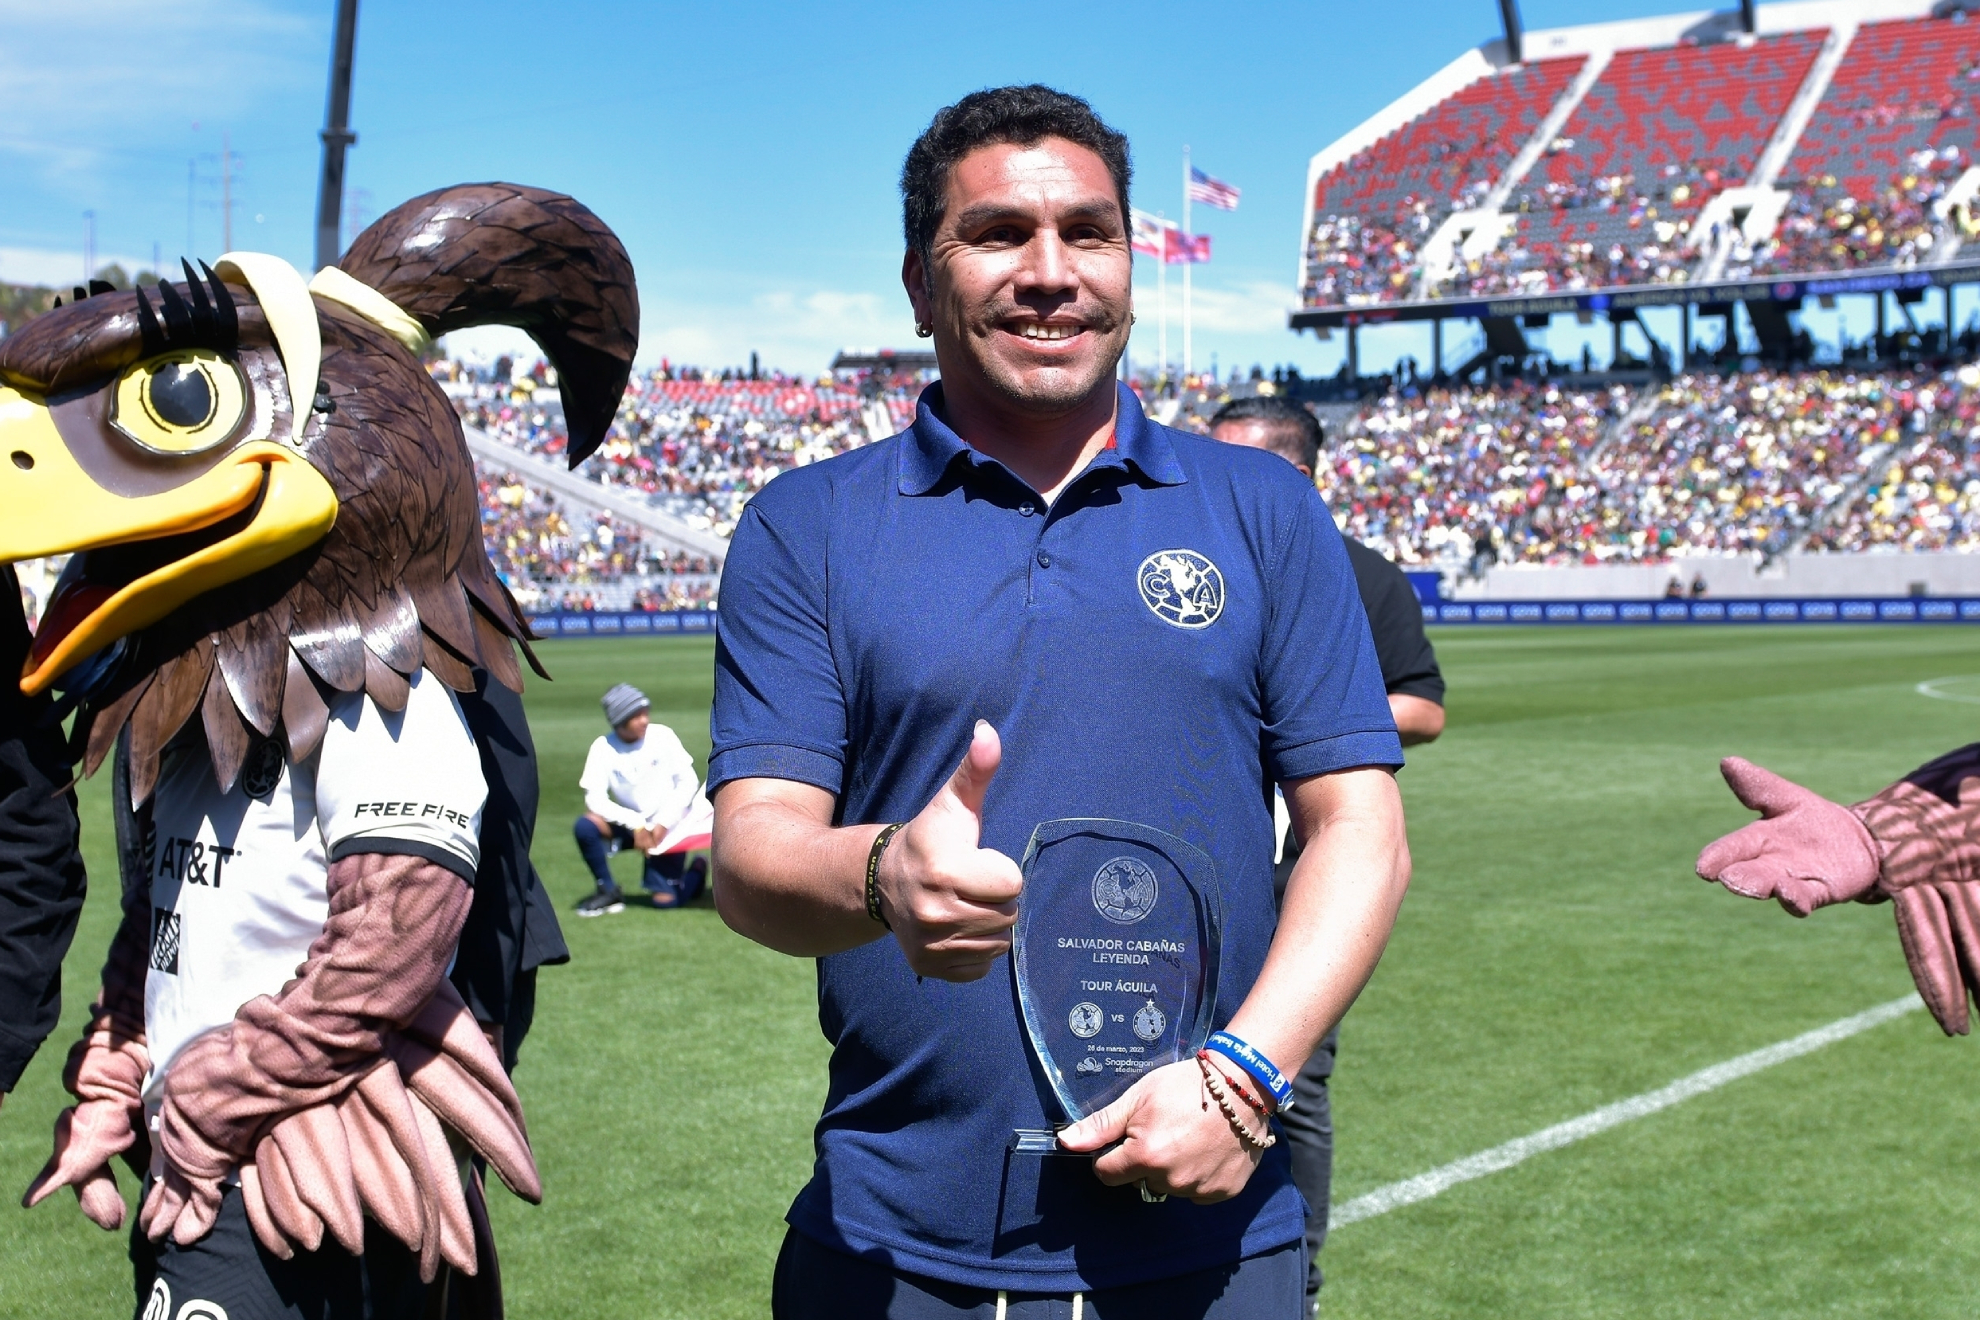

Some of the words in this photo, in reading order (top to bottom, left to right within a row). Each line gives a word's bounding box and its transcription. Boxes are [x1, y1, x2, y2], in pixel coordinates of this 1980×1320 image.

[354, 802, 418, 818] FREE
[158, 837, 234, 888] AT&T
[1057, 937, 1123, 951] SALVADOR
[1126, 939, 1186, 953] CABAÑAS
[1093, 953, 1150, 965] LEYENDA
[1080, 980, 1112, 992] TOUR
[1114, 979, 1158, 993] ÁGUILA
[1097, 1044, 1105, 1052] de
[1129, 1045, 1145, 1053] 2023
[1104, 1057, 1154, 1068] Snapdragon
[1255, 1059, 1276, 1081] Hotel
